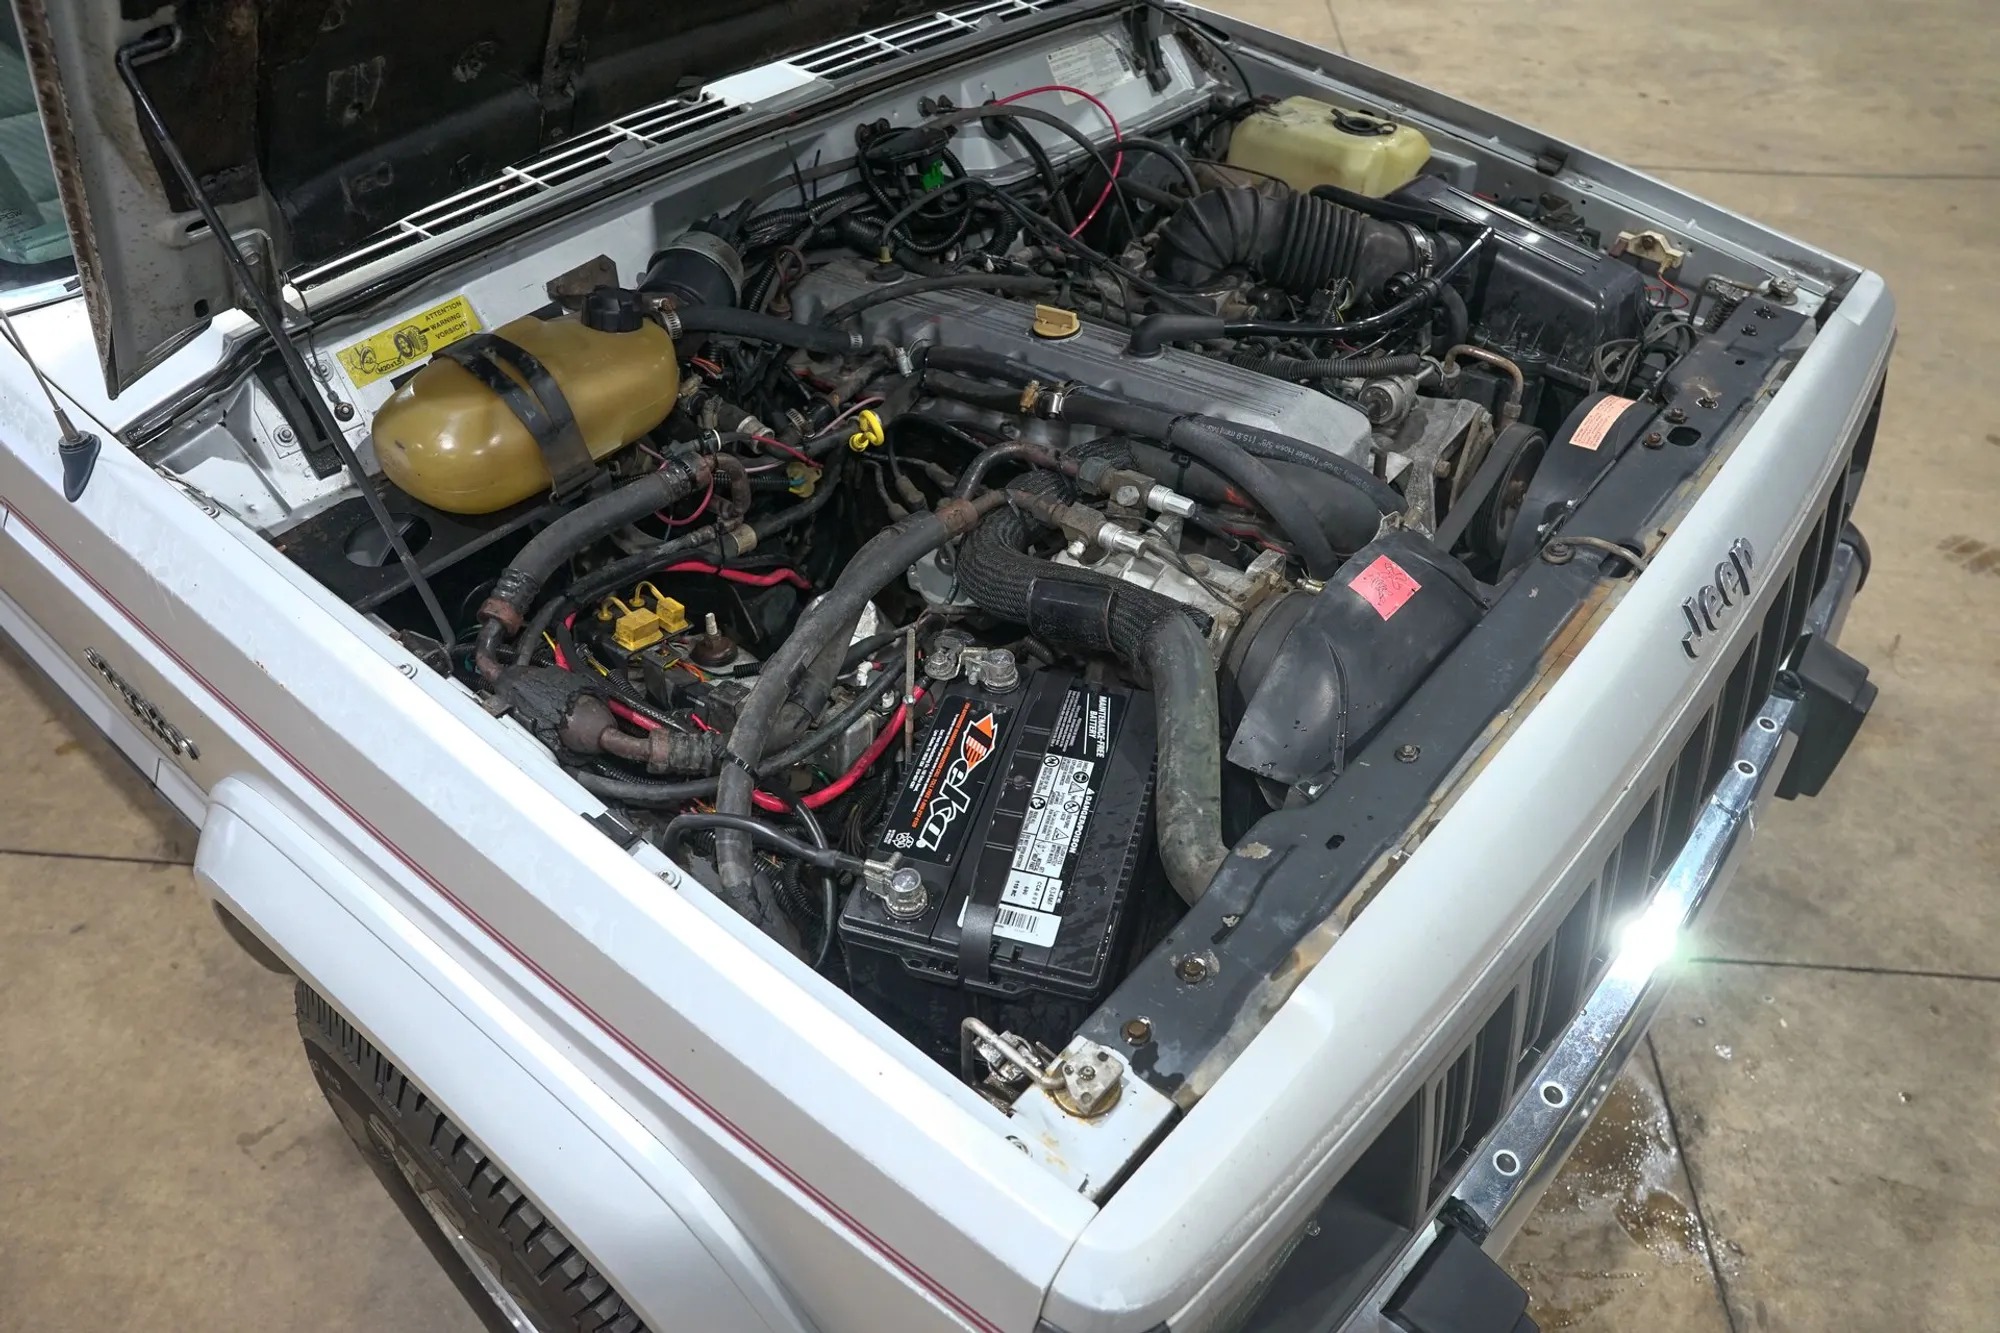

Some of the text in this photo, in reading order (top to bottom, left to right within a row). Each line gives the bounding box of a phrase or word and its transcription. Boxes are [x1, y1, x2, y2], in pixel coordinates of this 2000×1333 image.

[424, 299, 462, 322] ATTENTION
[429, 312, 461, 331] WARNING
[434, 320, 468, 340] VORSICHT
[1680, 537, 1755, 659] Jeep
[1088, 709, 1097, 738] BATTERY
[1094, 694, 1107, 759] MAINTENANCE-FREE
[917, 711, 998, 851] Deka
[1067, 794, 1092, 854] DANGER/POISON
